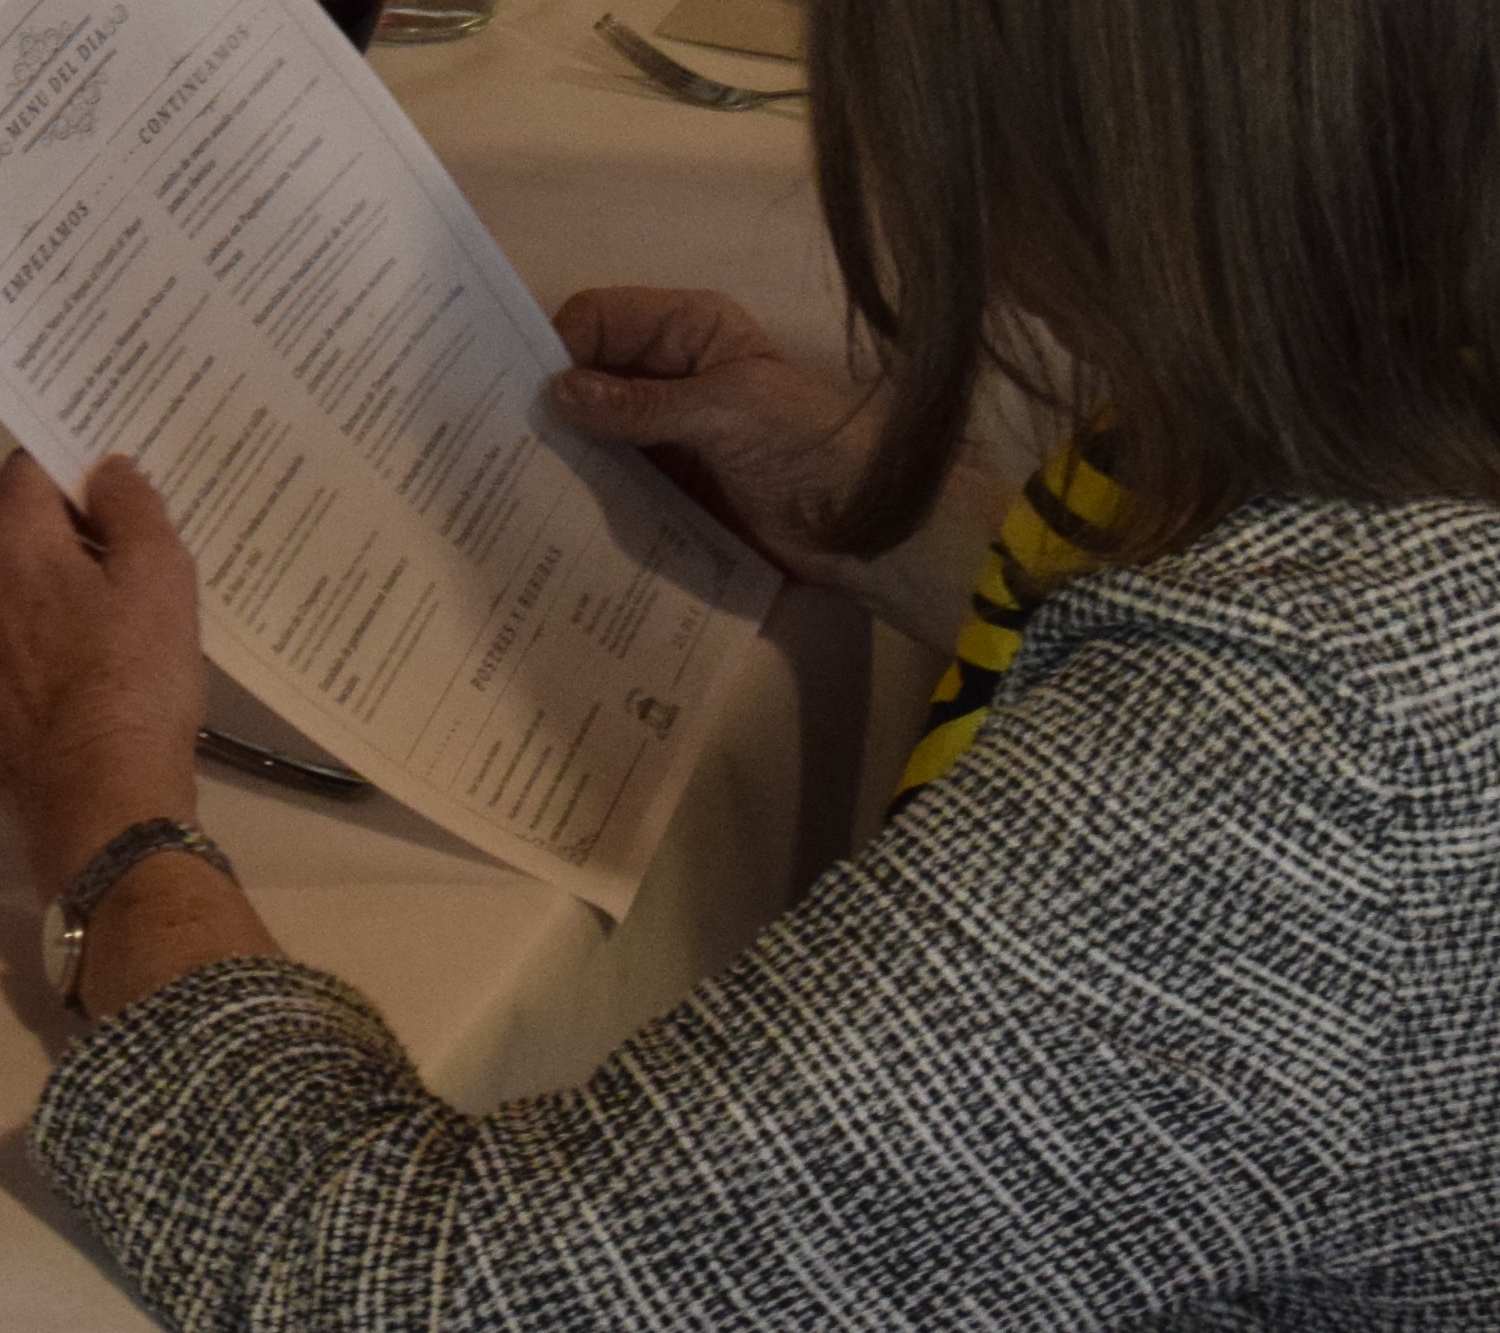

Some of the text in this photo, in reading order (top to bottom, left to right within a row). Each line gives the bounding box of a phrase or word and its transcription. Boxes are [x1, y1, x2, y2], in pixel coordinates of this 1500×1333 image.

[48, 60, 79, 93] DEL
[138, 24, 251, 145] CONTINUAMOS
[1, 199, 90, 304] EMPEZAMOS
